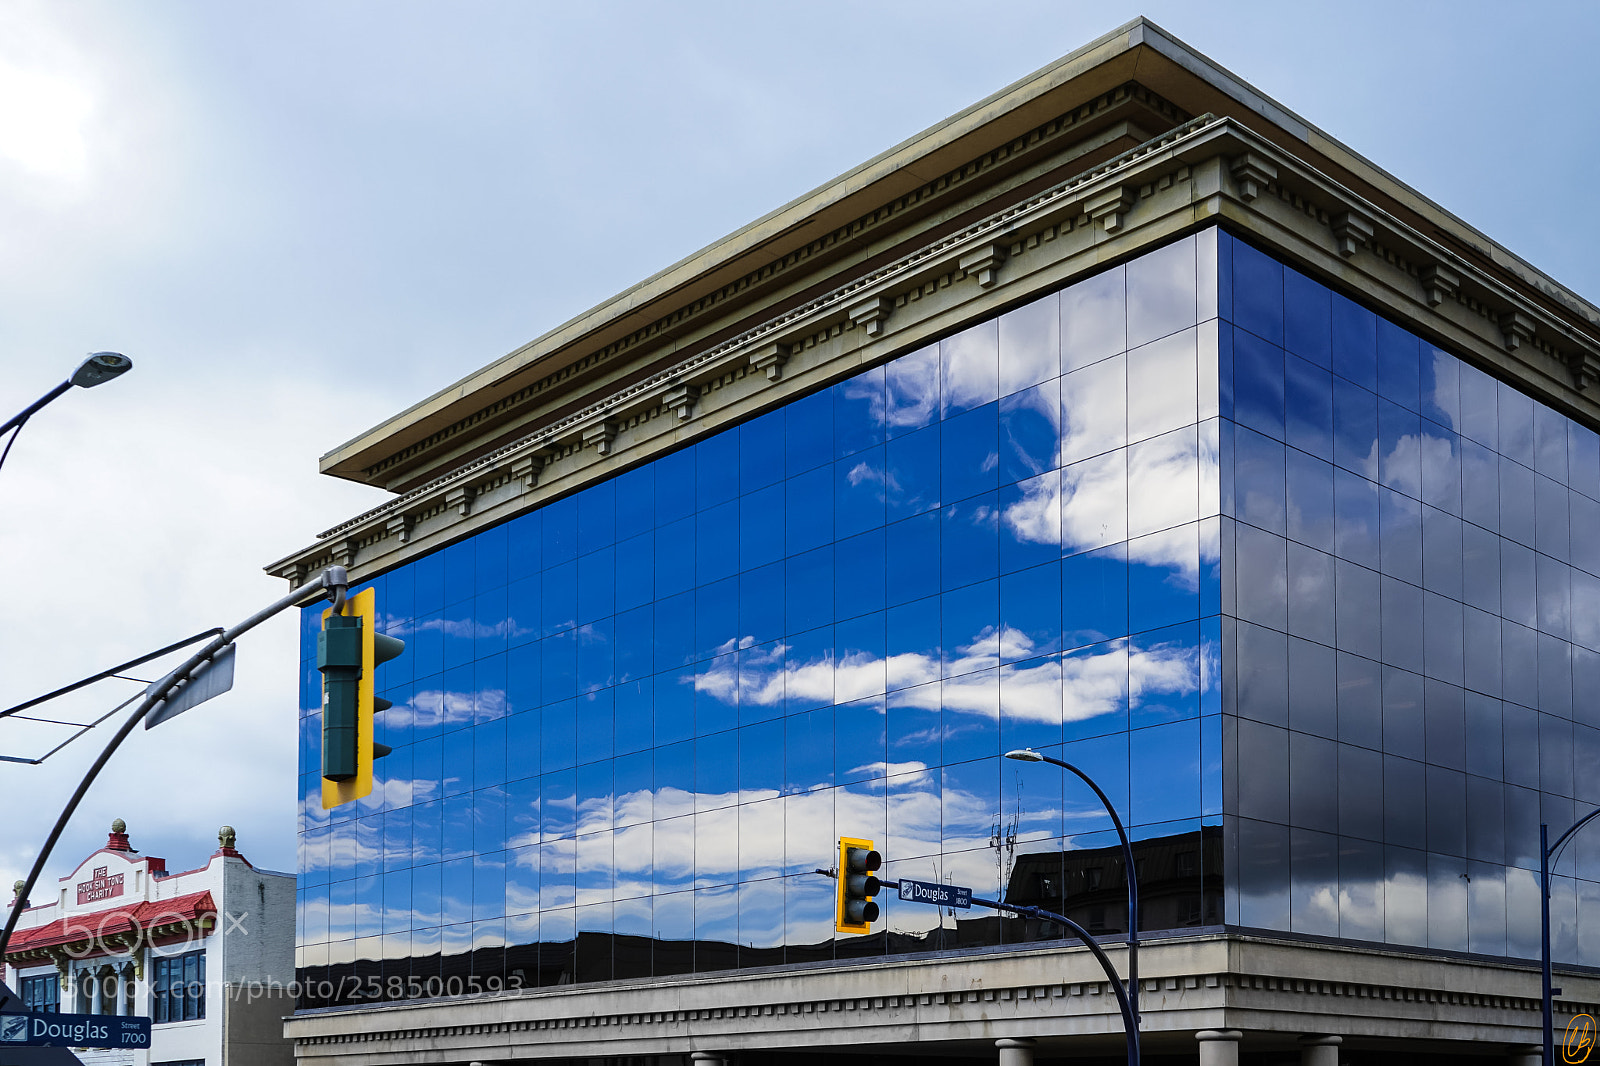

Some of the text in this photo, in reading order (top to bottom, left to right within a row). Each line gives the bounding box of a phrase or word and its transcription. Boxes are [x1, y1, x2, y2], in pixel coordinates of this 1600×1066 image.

[95, 868, 106, 878] THE
[95, 880, 106, 890] SIN
[87, 887, 114, 901] CHARITY
[915, 884, 949, 901] Douglas
[955, 897, 968, 906] 1800
[33, 1018, 109, 1042] Douglas
[121, 1021, 141, 1030] Street
[121, 1032, 147, 1044] 1700
